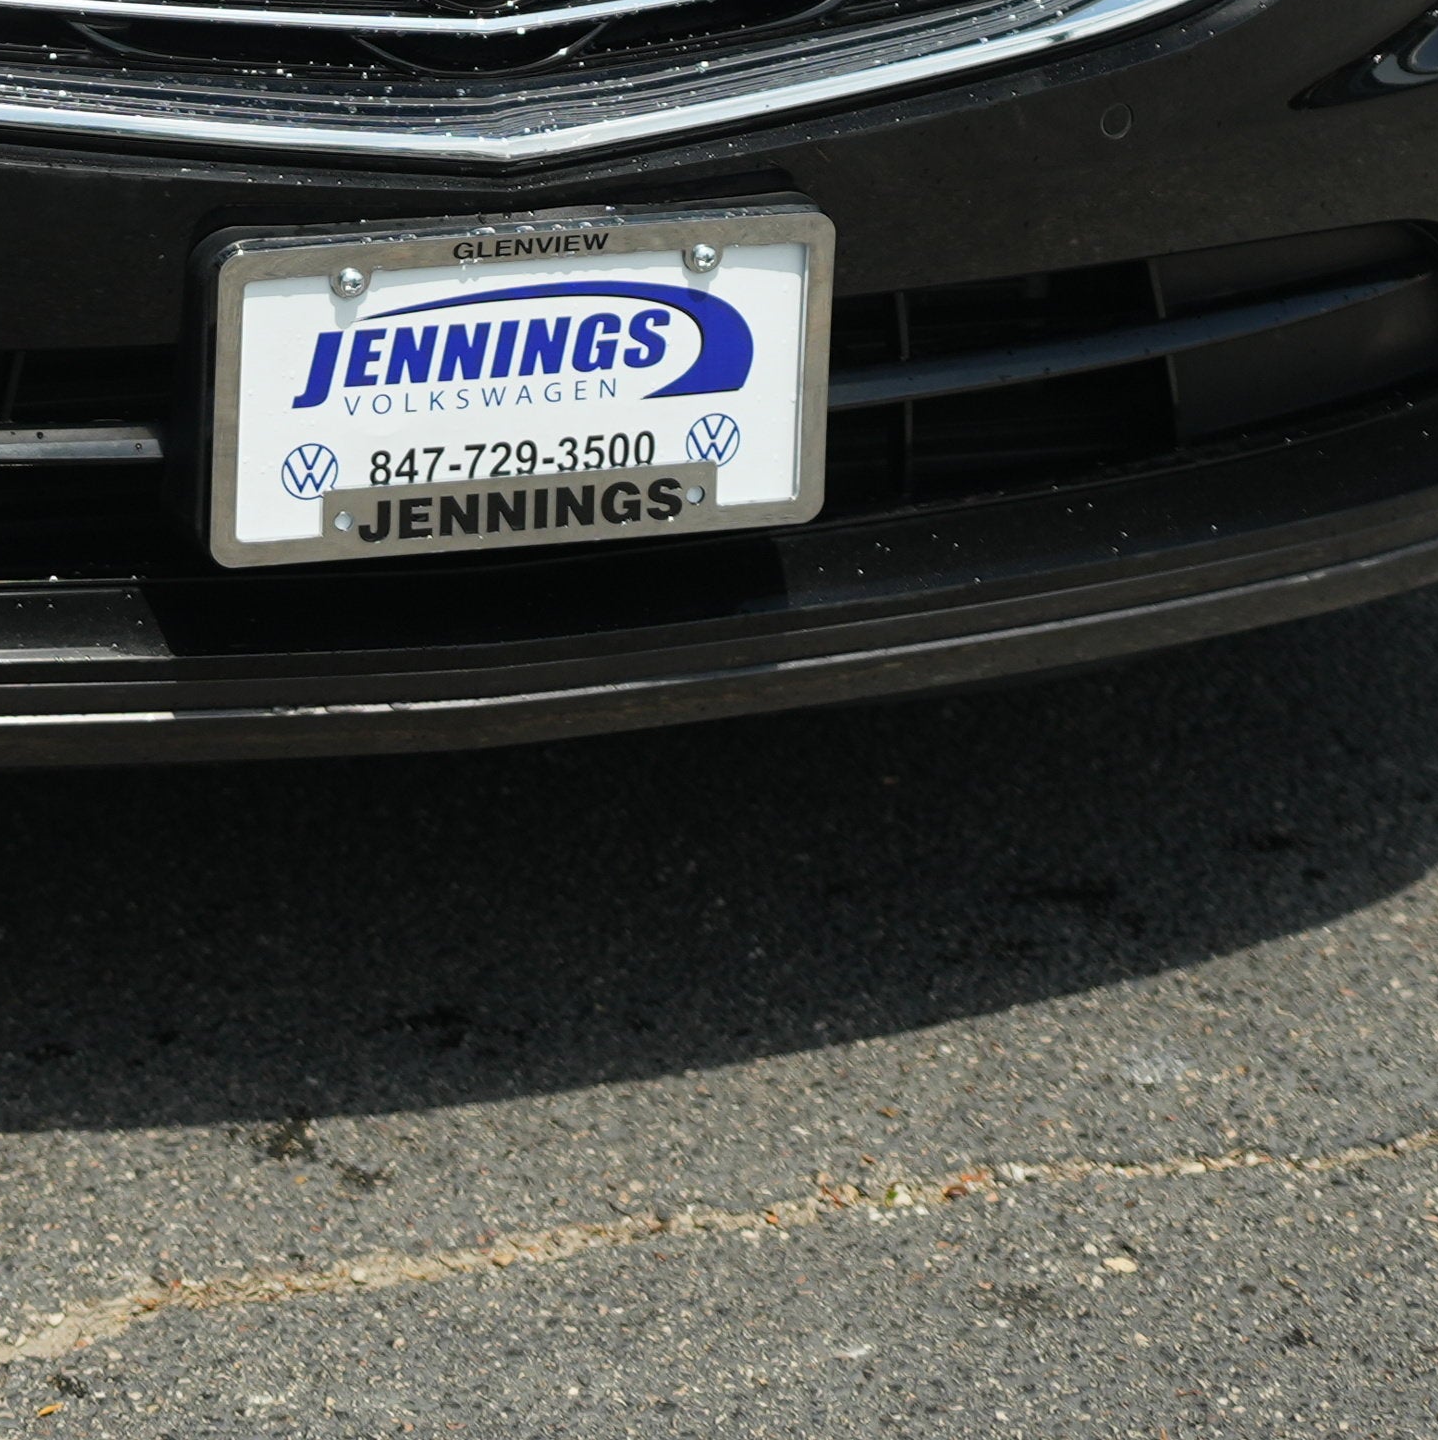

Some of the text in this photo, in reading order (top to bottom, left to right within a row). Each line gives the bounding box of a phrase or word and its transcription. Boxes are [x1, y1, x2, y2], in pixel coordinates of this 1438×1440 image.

[451, 232, 611, 261] GLENVIEW
[291, 308, 673, 410] JENNINGS
[343, 378, 618, 416] VOLKSWAGEN
[369, 431, 656, 485] 847-729-3500
[358, 479, 684, 543] JENNINGS
